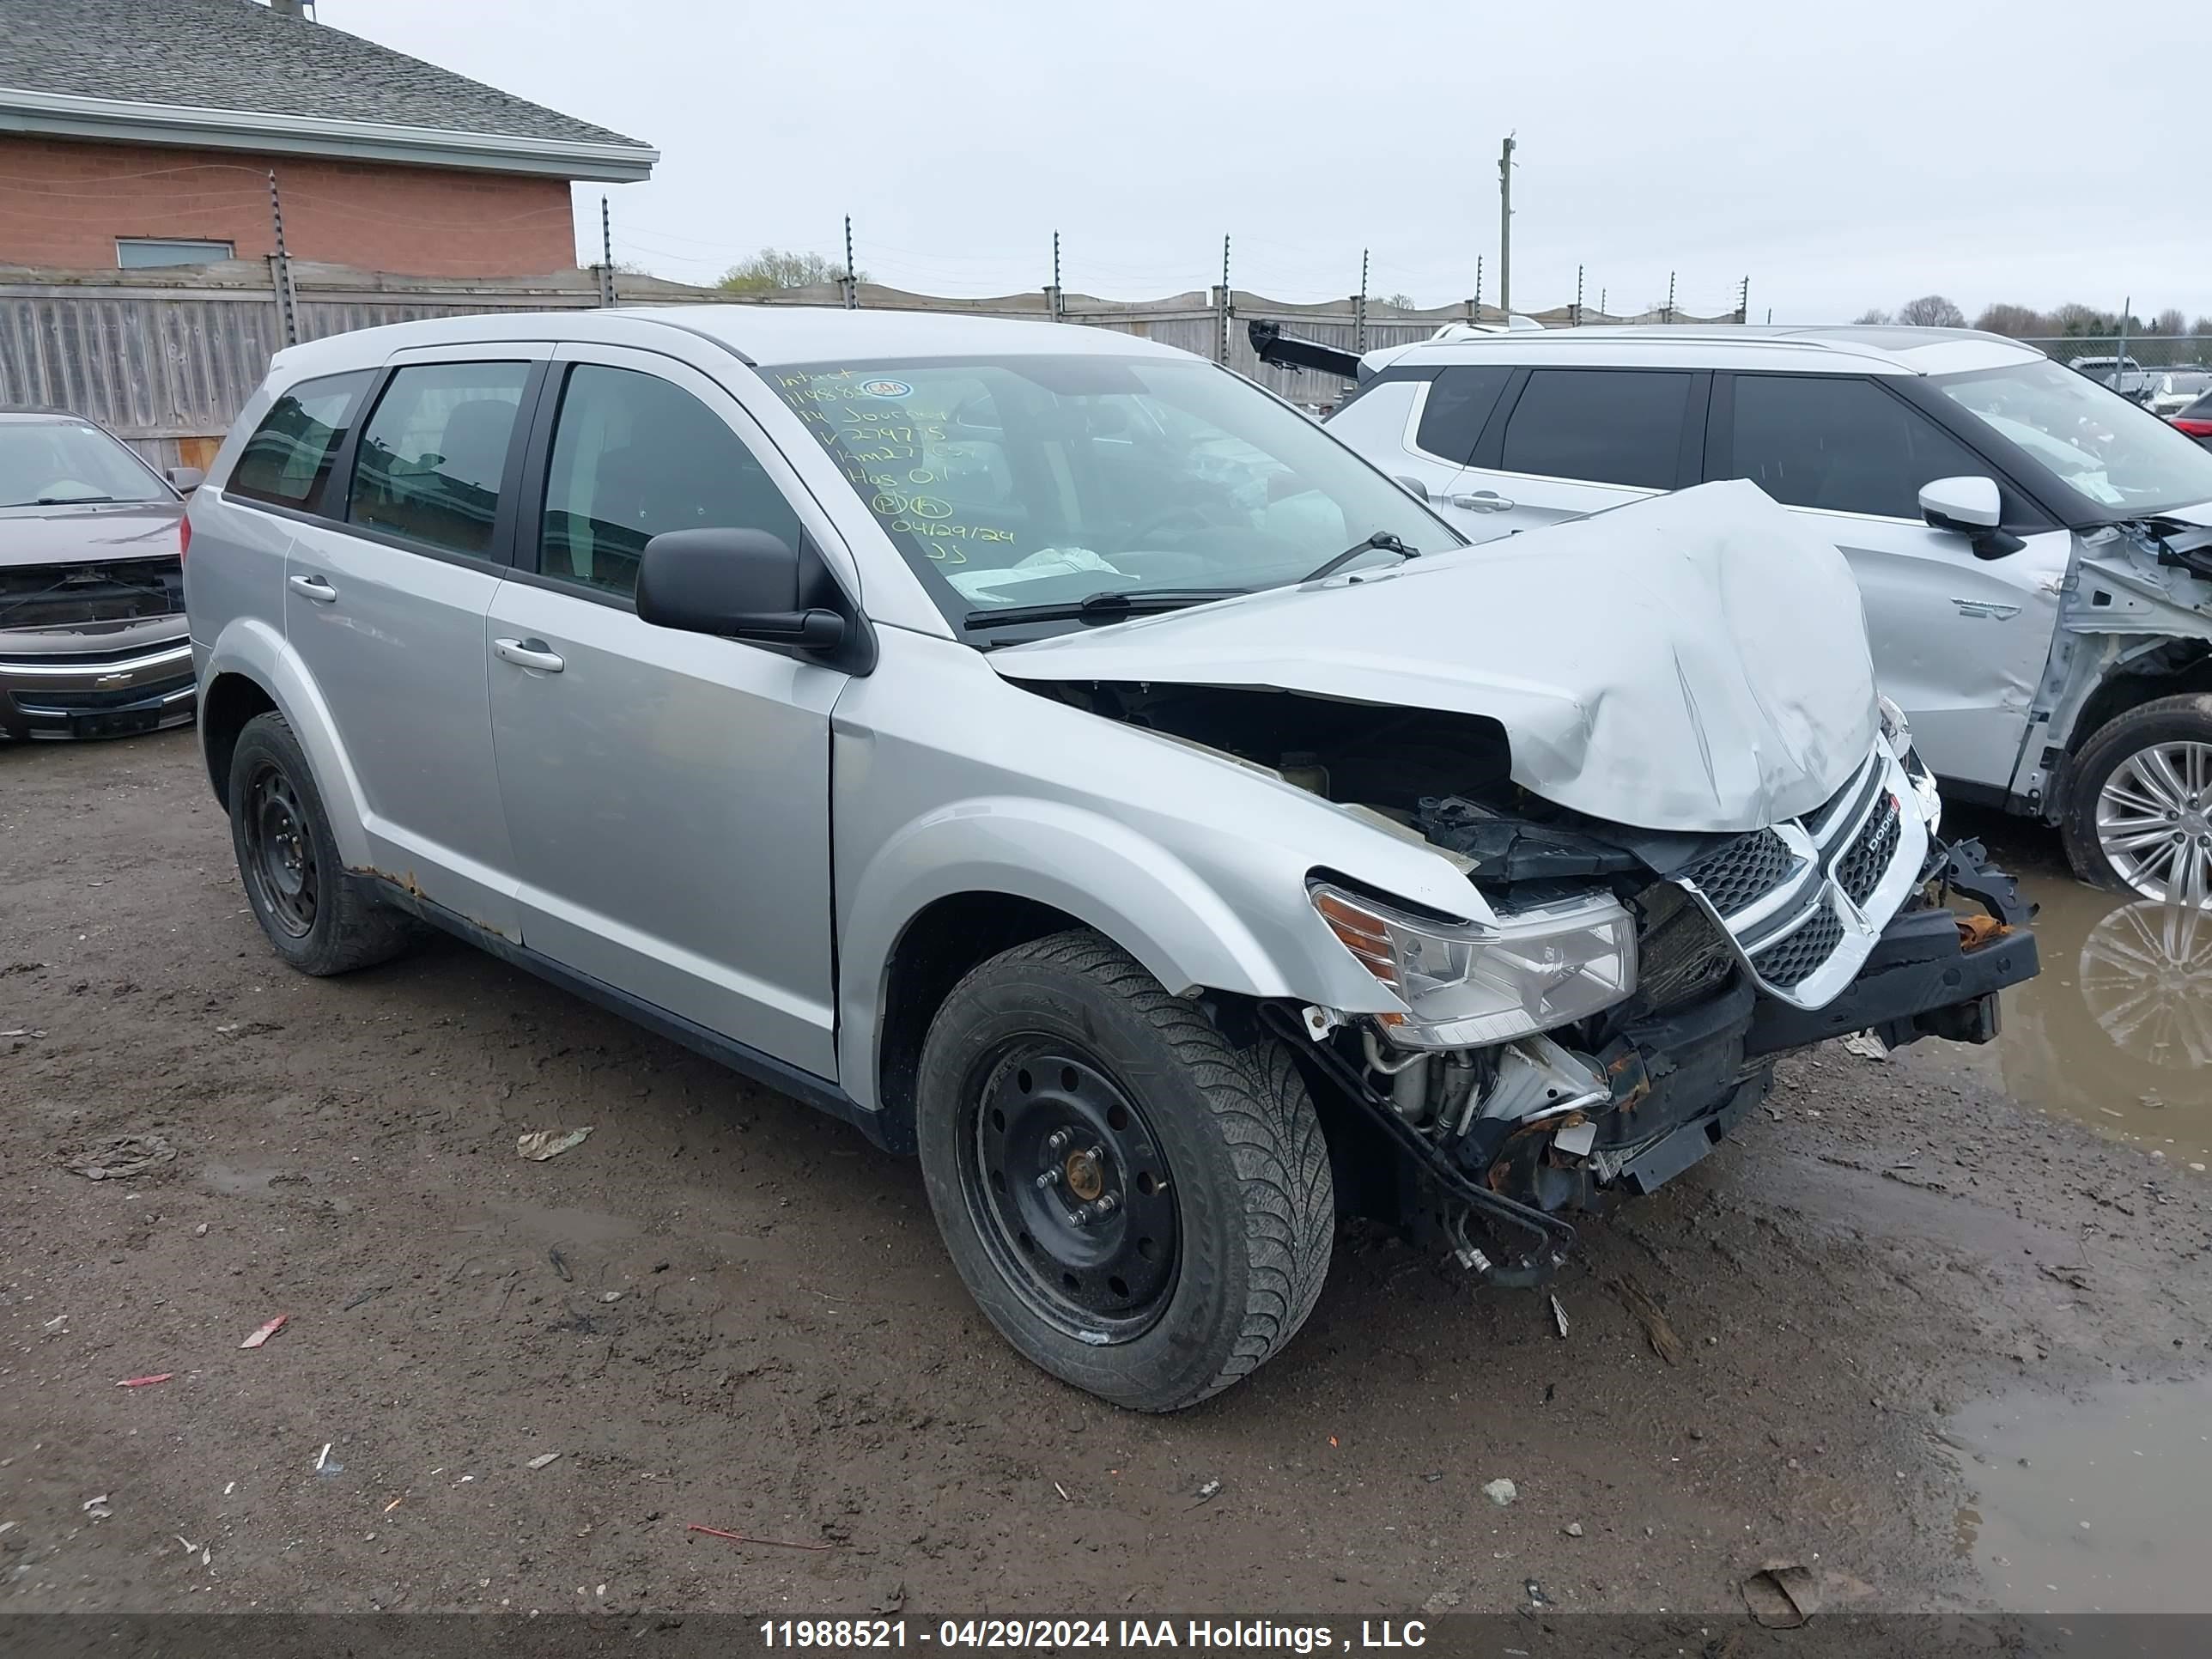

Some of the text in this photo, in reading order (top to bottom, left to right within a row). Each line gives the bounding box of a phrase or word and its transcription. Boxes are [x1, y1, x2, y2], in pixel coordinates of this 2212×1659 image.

[847, 466, 949, 487] Has Oil
[891, 520, 1016, 544] 04/29/24
[1869, 805, 1899, 852] DODGE
